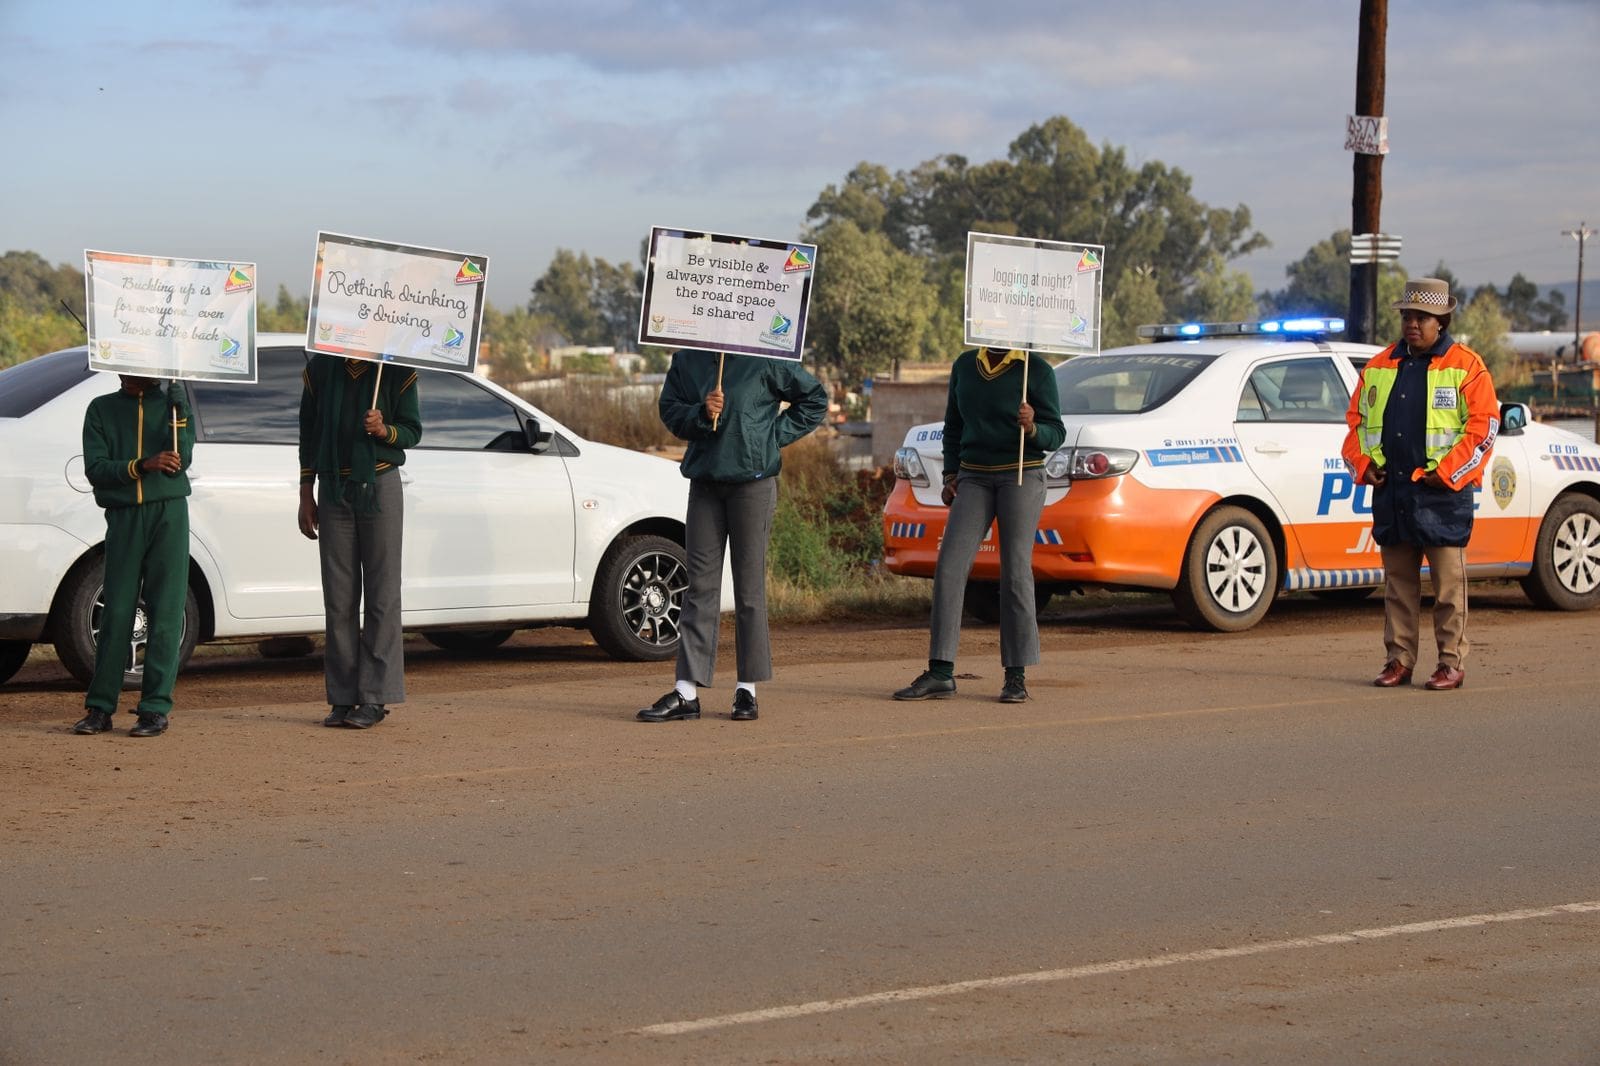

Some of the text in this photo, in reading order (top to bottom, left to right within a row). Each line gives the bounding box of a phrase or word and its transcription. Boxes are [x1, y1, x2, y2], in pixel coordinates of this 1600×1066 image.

[687, 254, 705, 267] Be
[708, 256, 753, 272] visible
[756, 261, 769, 274] &
[121, 276, 175, 304] Buckling
[179, 285, 196, 305] up
[200, 285, 212, 296] is
[666, 270, 790, 293] always remember
[992, 267, 1073, 291] Jogging at night?
[327, 270, 468, 319] Rethink drinking
[676, 286, 776, 308] the road space
[979, 287, 1078, 313] Wear visible clothing.
[113, 297, 132, 318] for
[198, 310, 225, 319] even
[357, 302, 371, 319] &
[373, 304, 433, 337] driving
[692, 304, 755, 322] is shared
[119, 319, 220, 341] those at the back
